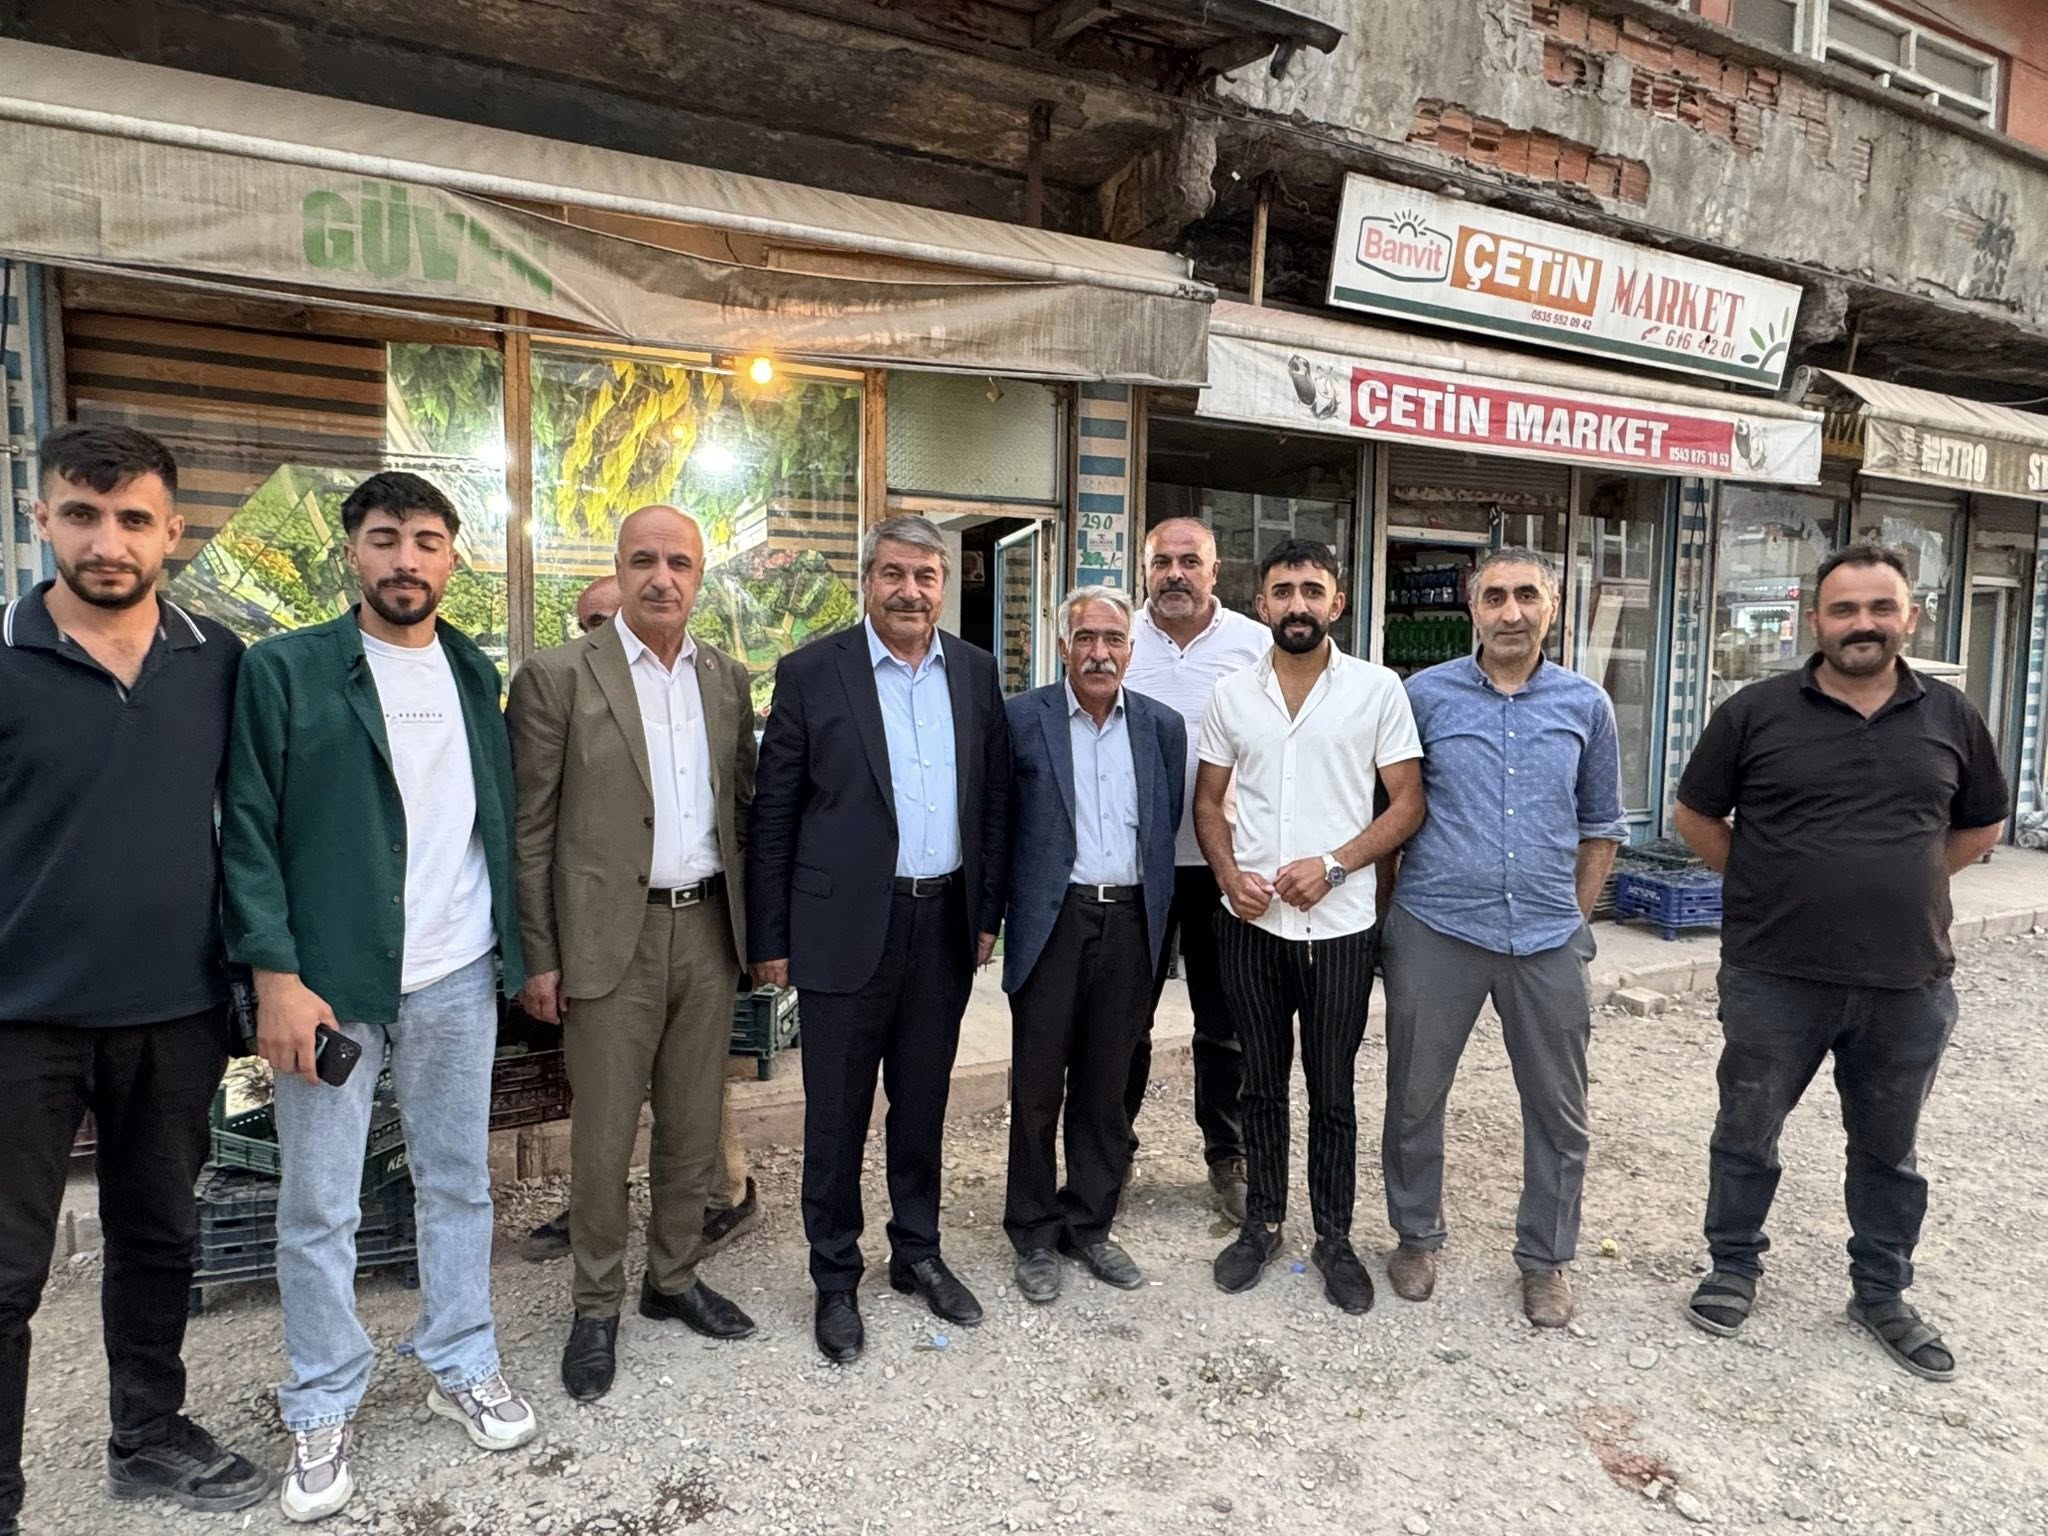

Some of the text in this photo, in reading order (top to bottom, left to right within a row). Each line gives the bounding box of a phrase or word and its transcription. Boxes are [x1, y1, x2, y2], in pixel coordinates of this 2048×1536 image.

[1364, 227, 1443, 273] Banvit
[1531, 308, 1592, 331] 0535 552 09 42
[1610, 265, 1745, 338] MARKET
[1665, 329, 1692, 351] 616
[1698, 336, 1718, 356] 42
[1506, 401, 1669, 458] MARKET
[1669, 446, 1689, 463] 0543
[1719, 453, 1729, 467] 53
[1921, 432, 1988, 483] METRO
[1081, 513, 1113, 530] 290
